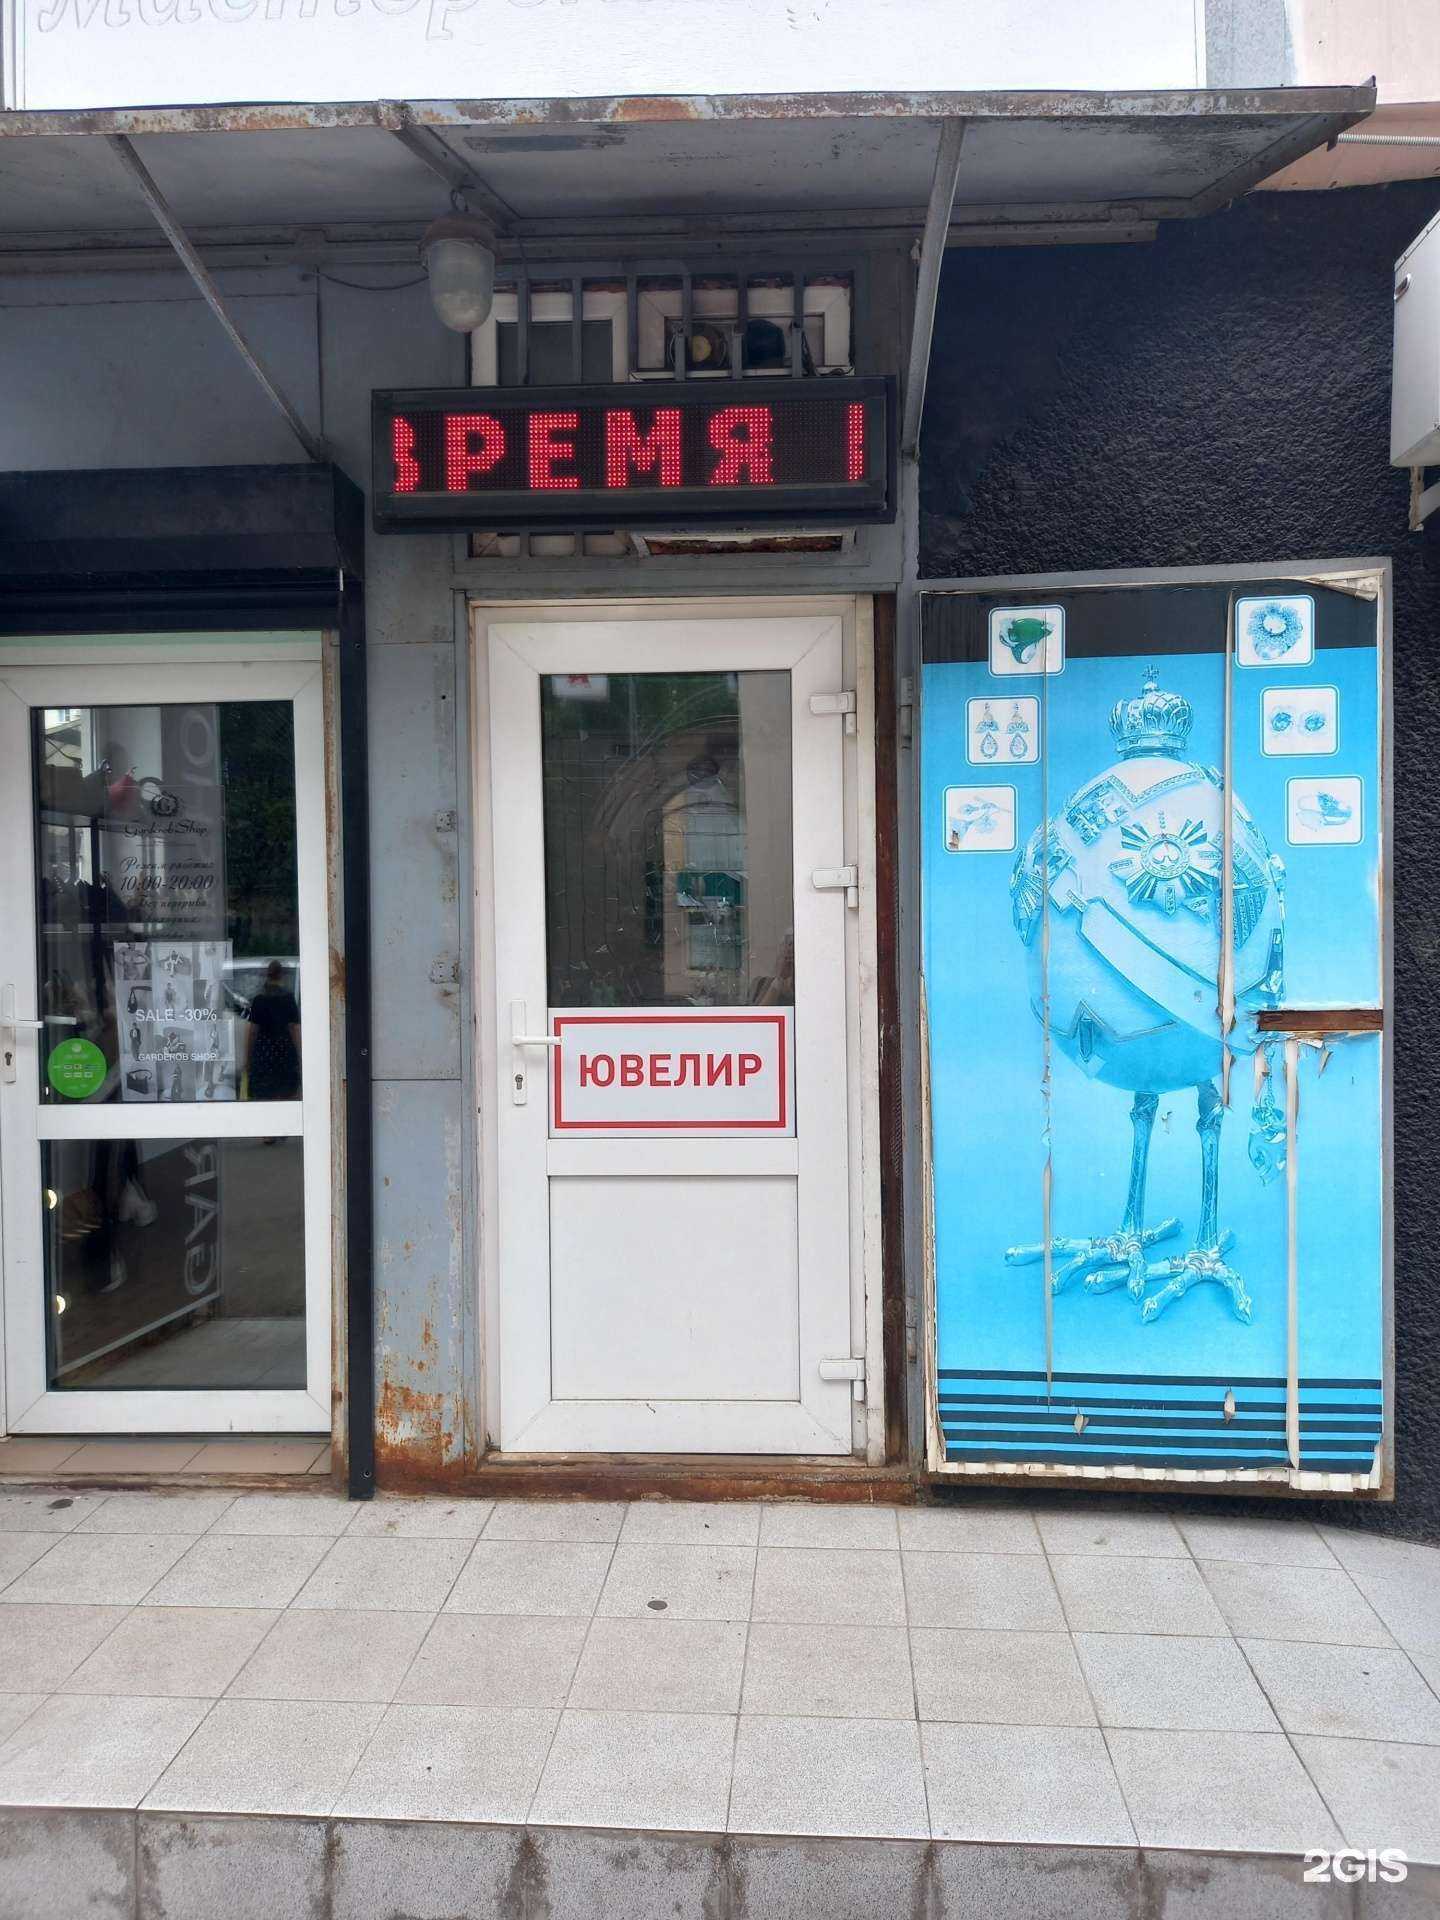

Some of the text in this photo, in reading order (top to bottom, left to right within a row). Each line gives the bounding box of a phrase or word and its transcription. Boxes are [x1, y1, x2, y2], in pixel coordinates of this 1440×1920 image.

[120, 874, 215, 892] 10:00-20:00
[136, 1007, 217, 1022] SALE -30%
[138, 1052, 217, 1062] GARDEROB SHOP
[579, 1053, 763, 1088] ЮВЕЛИР
